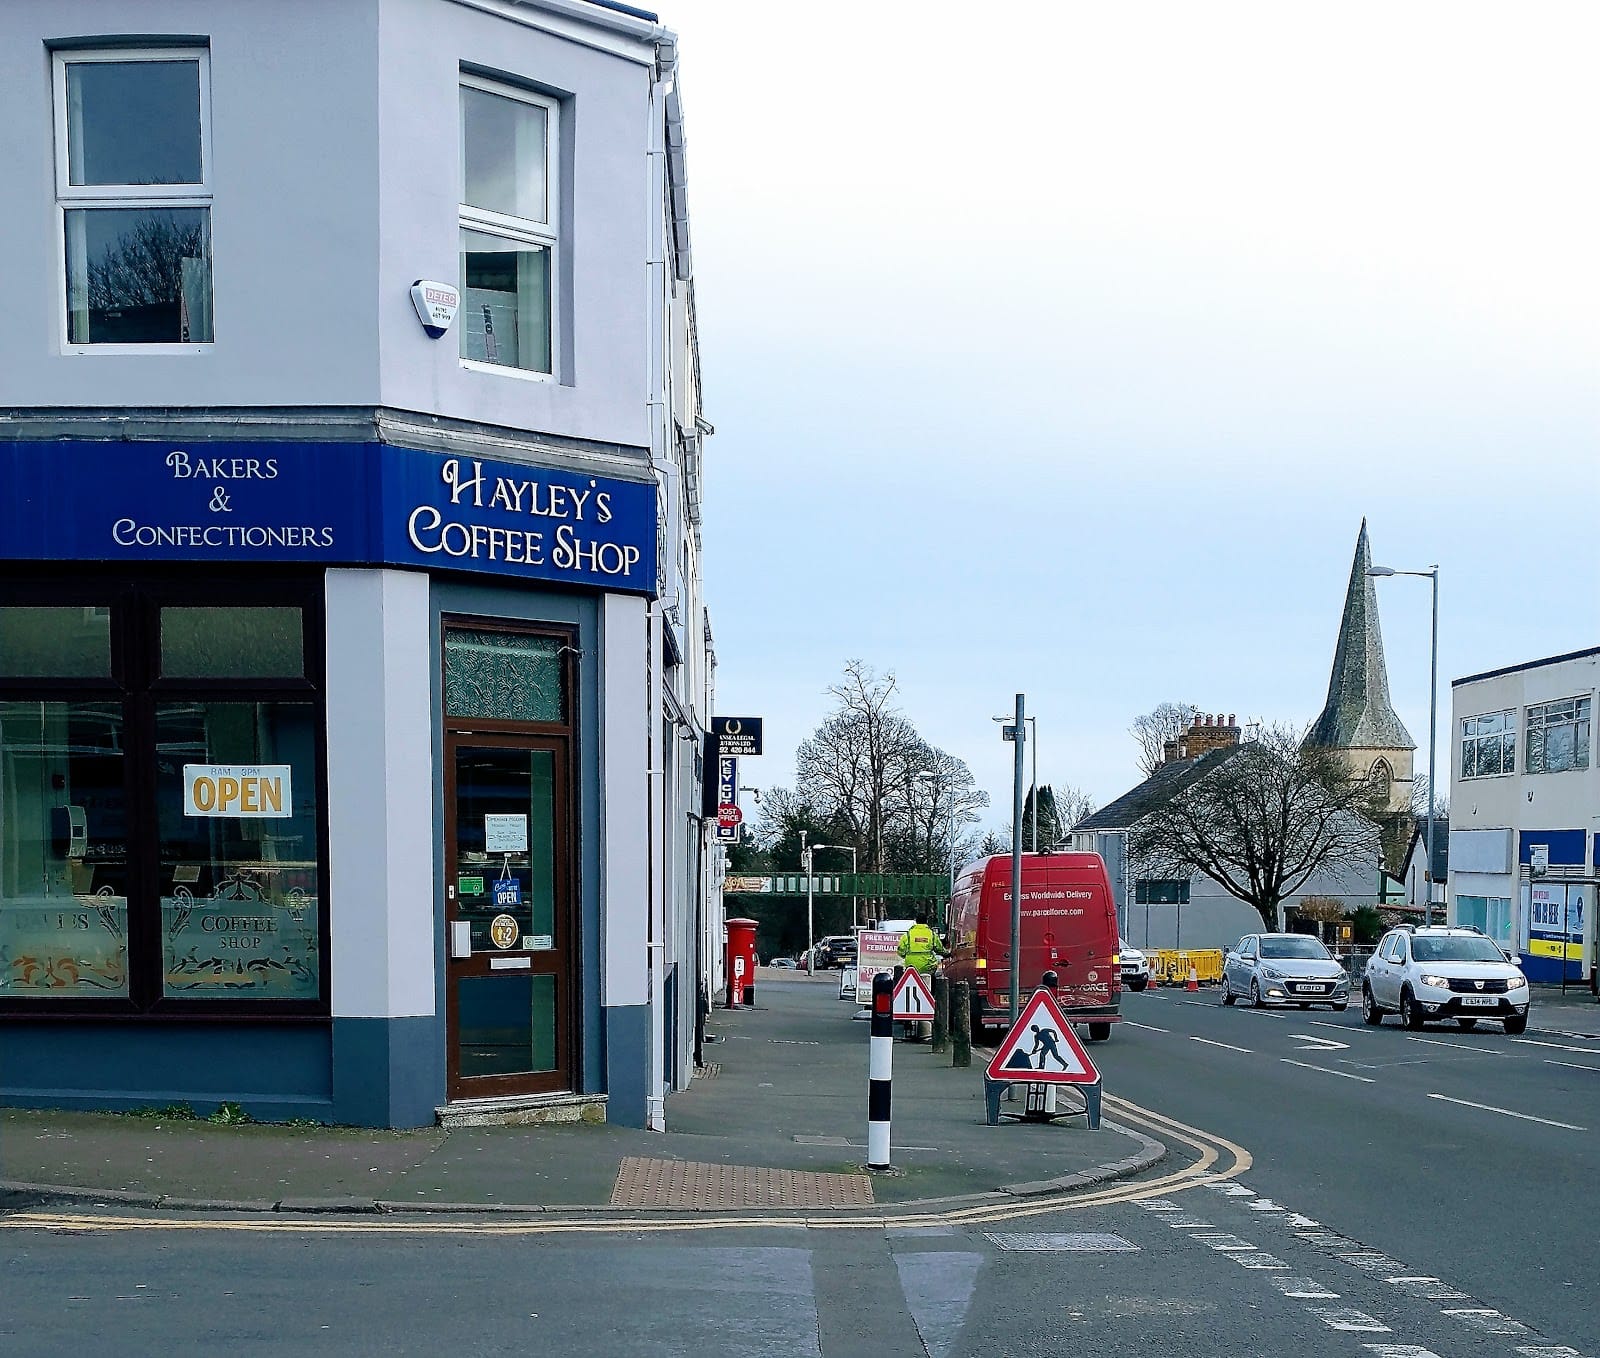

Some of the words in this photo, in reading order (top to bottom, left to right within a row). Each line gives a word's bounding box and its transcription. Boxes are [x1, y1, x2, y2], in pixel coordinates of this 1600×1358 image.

[165, 451, 278, 479] BAKERS
[208, 486, 233, 512] &
[442, 459, 612, 523] HAYLEY'S
[112, 518, 334, 547] CONFECTIONERS
[408, 505, 545, 565] COFFEE
[552, 525, 640, 576] SHOP
[210, 768, 231, 776] 8AM
[240, 768, 260, 776] 3PM
[722, 759, 733, 782] KEY
[193, 776, 282, 812] OPEN
[497, 891, 518, 904] OPEN
[1030, 891, 1065, 899] Worldwide
[1066, 890, 1092, 900] Delivery
[201, 916, 279, 932] COFFEE
[219, 936, 261, 949] SHOP
[866, 944, 898, 952] FEBRUAR
